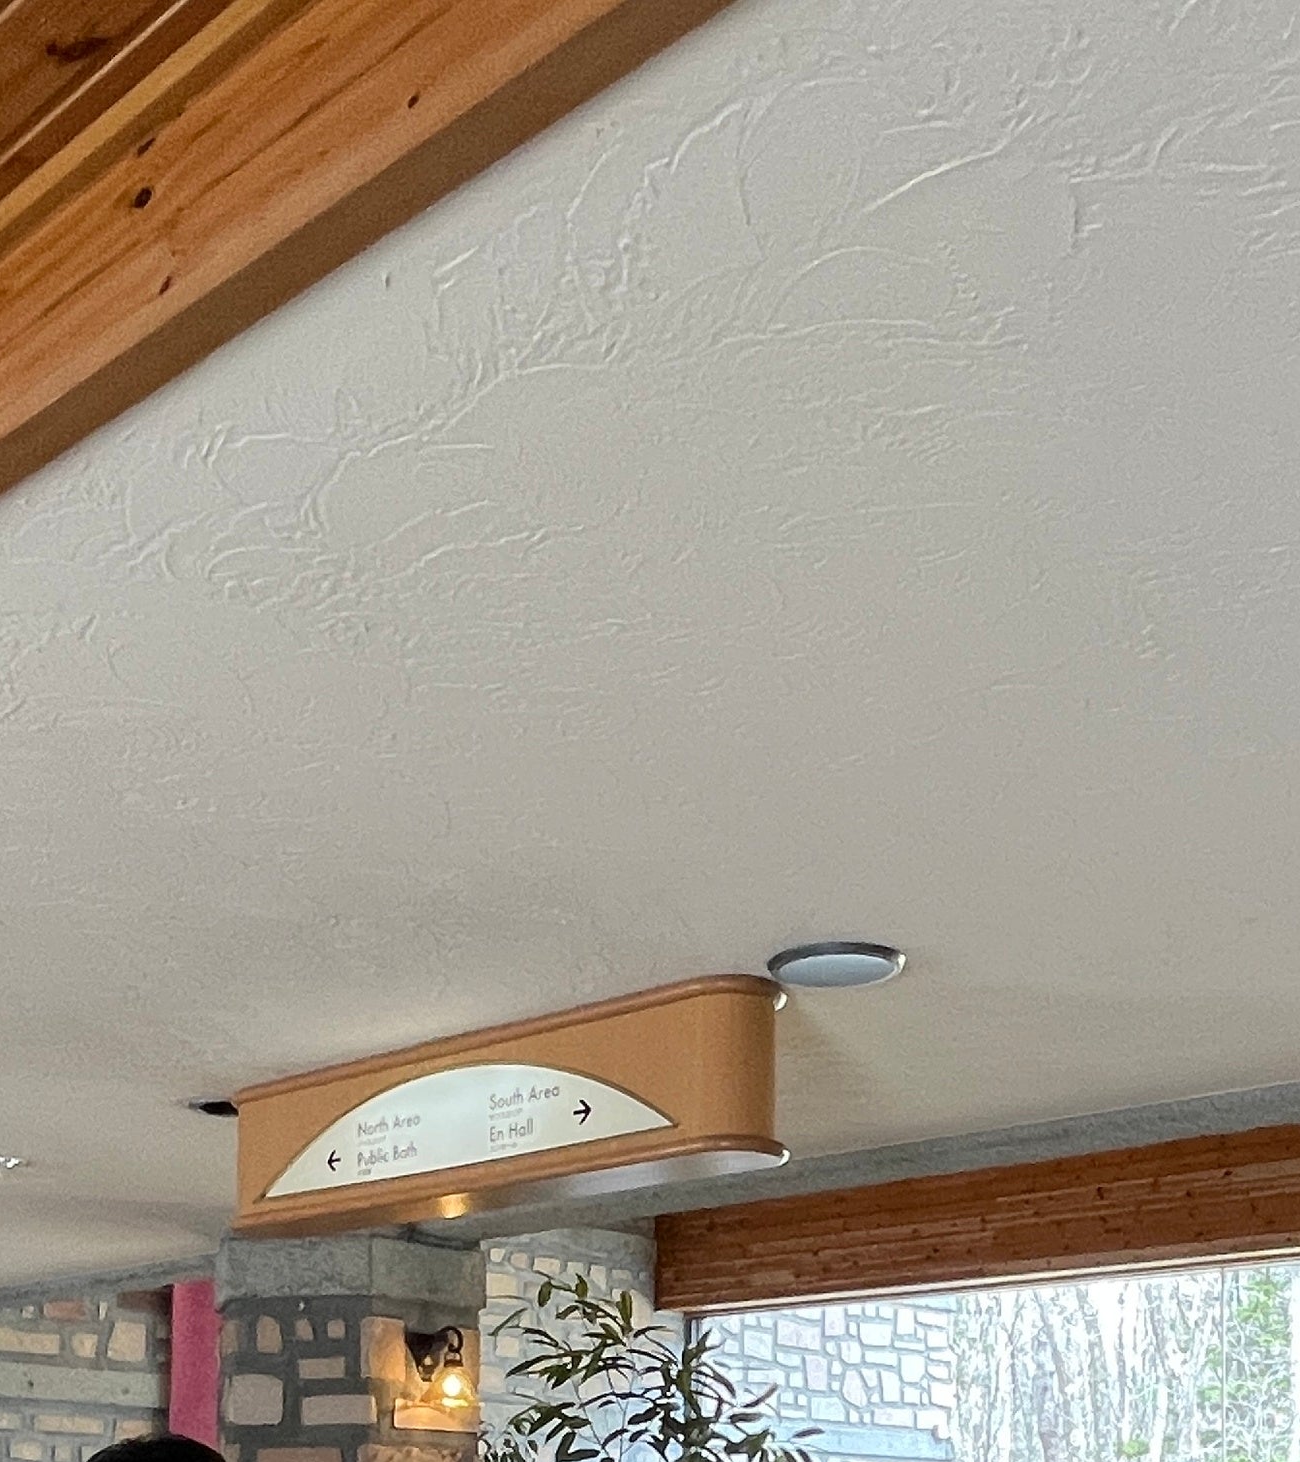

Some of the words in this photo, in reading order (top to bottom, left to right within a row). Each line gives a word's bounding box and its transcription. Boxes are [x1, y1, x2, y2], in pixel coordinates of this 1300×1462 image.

[489, 1087, 524, 1111] South
[528, 1085, 560, 1103] Area
[357, 1116, 389, 1137] North
[393, 1114, 420, 1129] Area
[489, 1126, 504, 1143] En
[508, 1118, 534, 1139] Hall
[357, 1147, 389, 1167] Public
[393, 1141, 418, 1161] Bath
